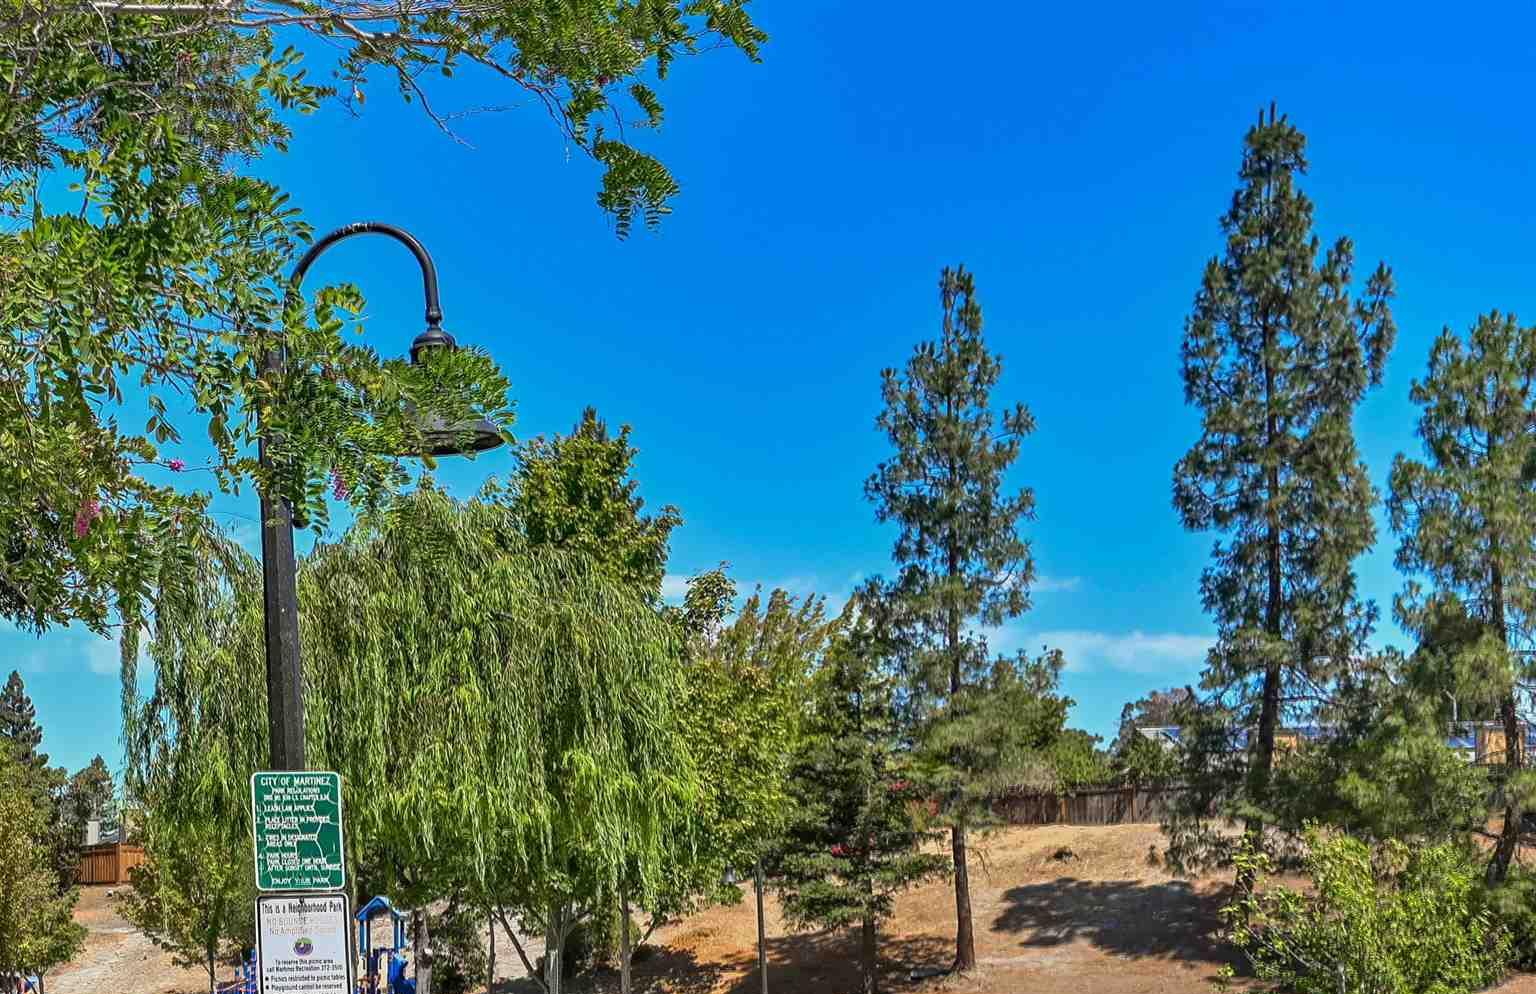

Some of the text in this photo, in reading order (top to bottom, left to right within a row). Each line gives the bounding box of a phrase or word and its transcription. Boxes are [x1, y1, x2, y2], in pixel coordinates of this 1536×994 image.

[260, 776, 331, 786] CITY OF MARTINEZ
[262, 903, 273, 914] This
[288, 903, 327, 914] Neighborhood
[329, 901, 342, 913] Park
